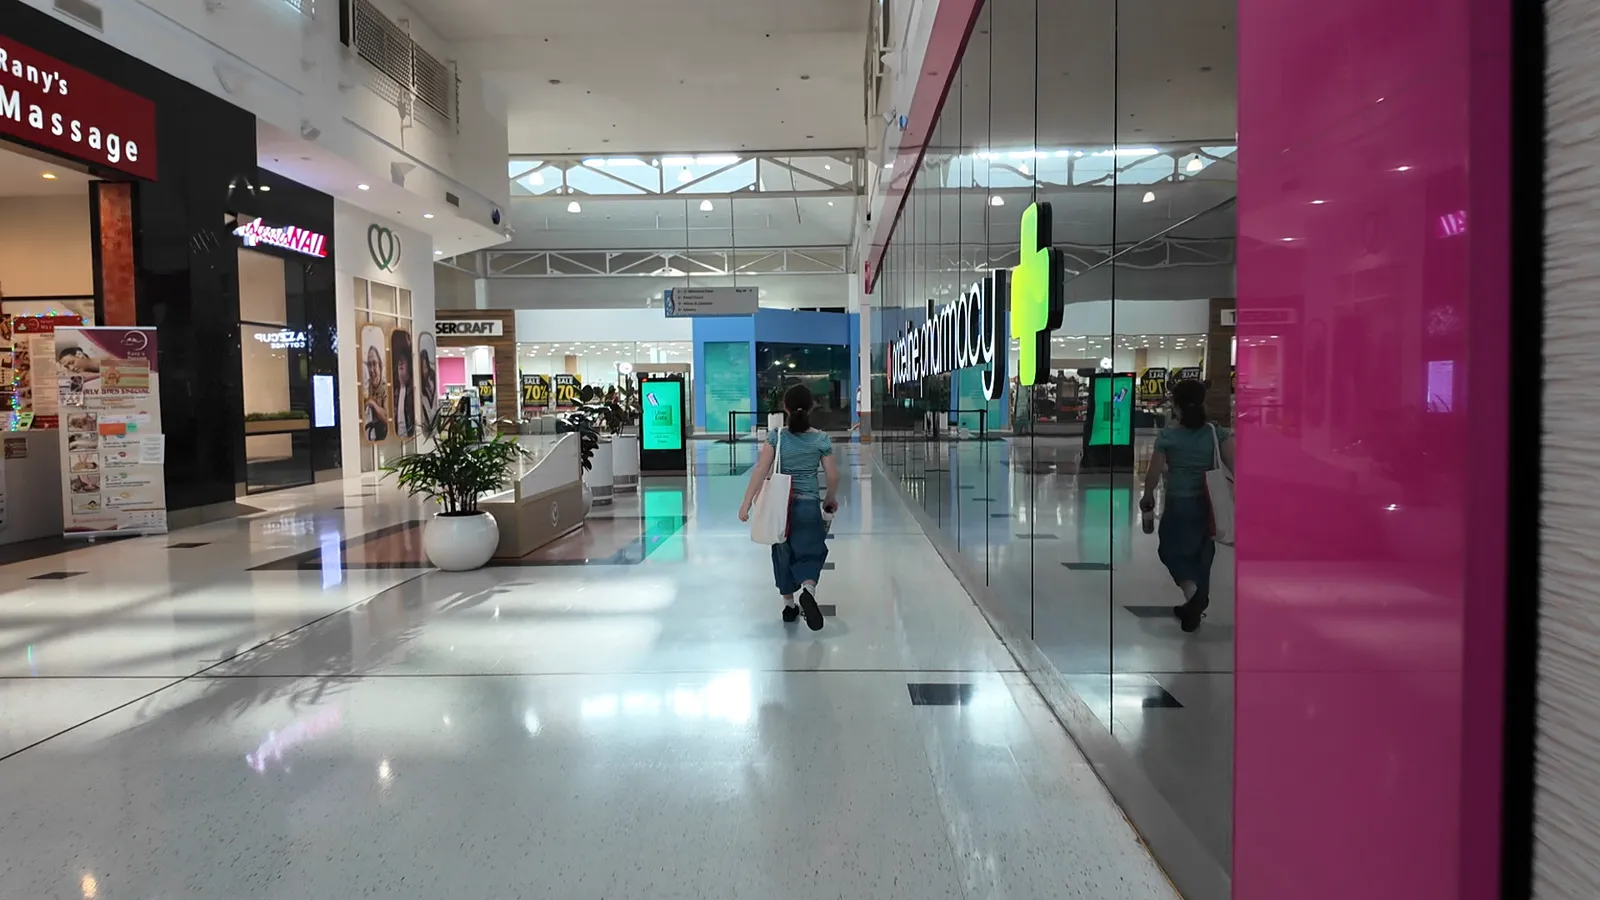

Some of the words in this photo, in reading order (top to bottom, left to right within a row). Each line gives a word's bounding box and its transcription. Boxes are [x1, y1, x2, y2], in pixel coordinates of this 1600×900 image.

[0, 48, 68, 96] Rany's
[0, 84, 138, 163] Massage
[285, 225, 327, 258] NAIL
[920, 269, 996, 401] pharmacy
[524, 385, 548, 400] 70%
